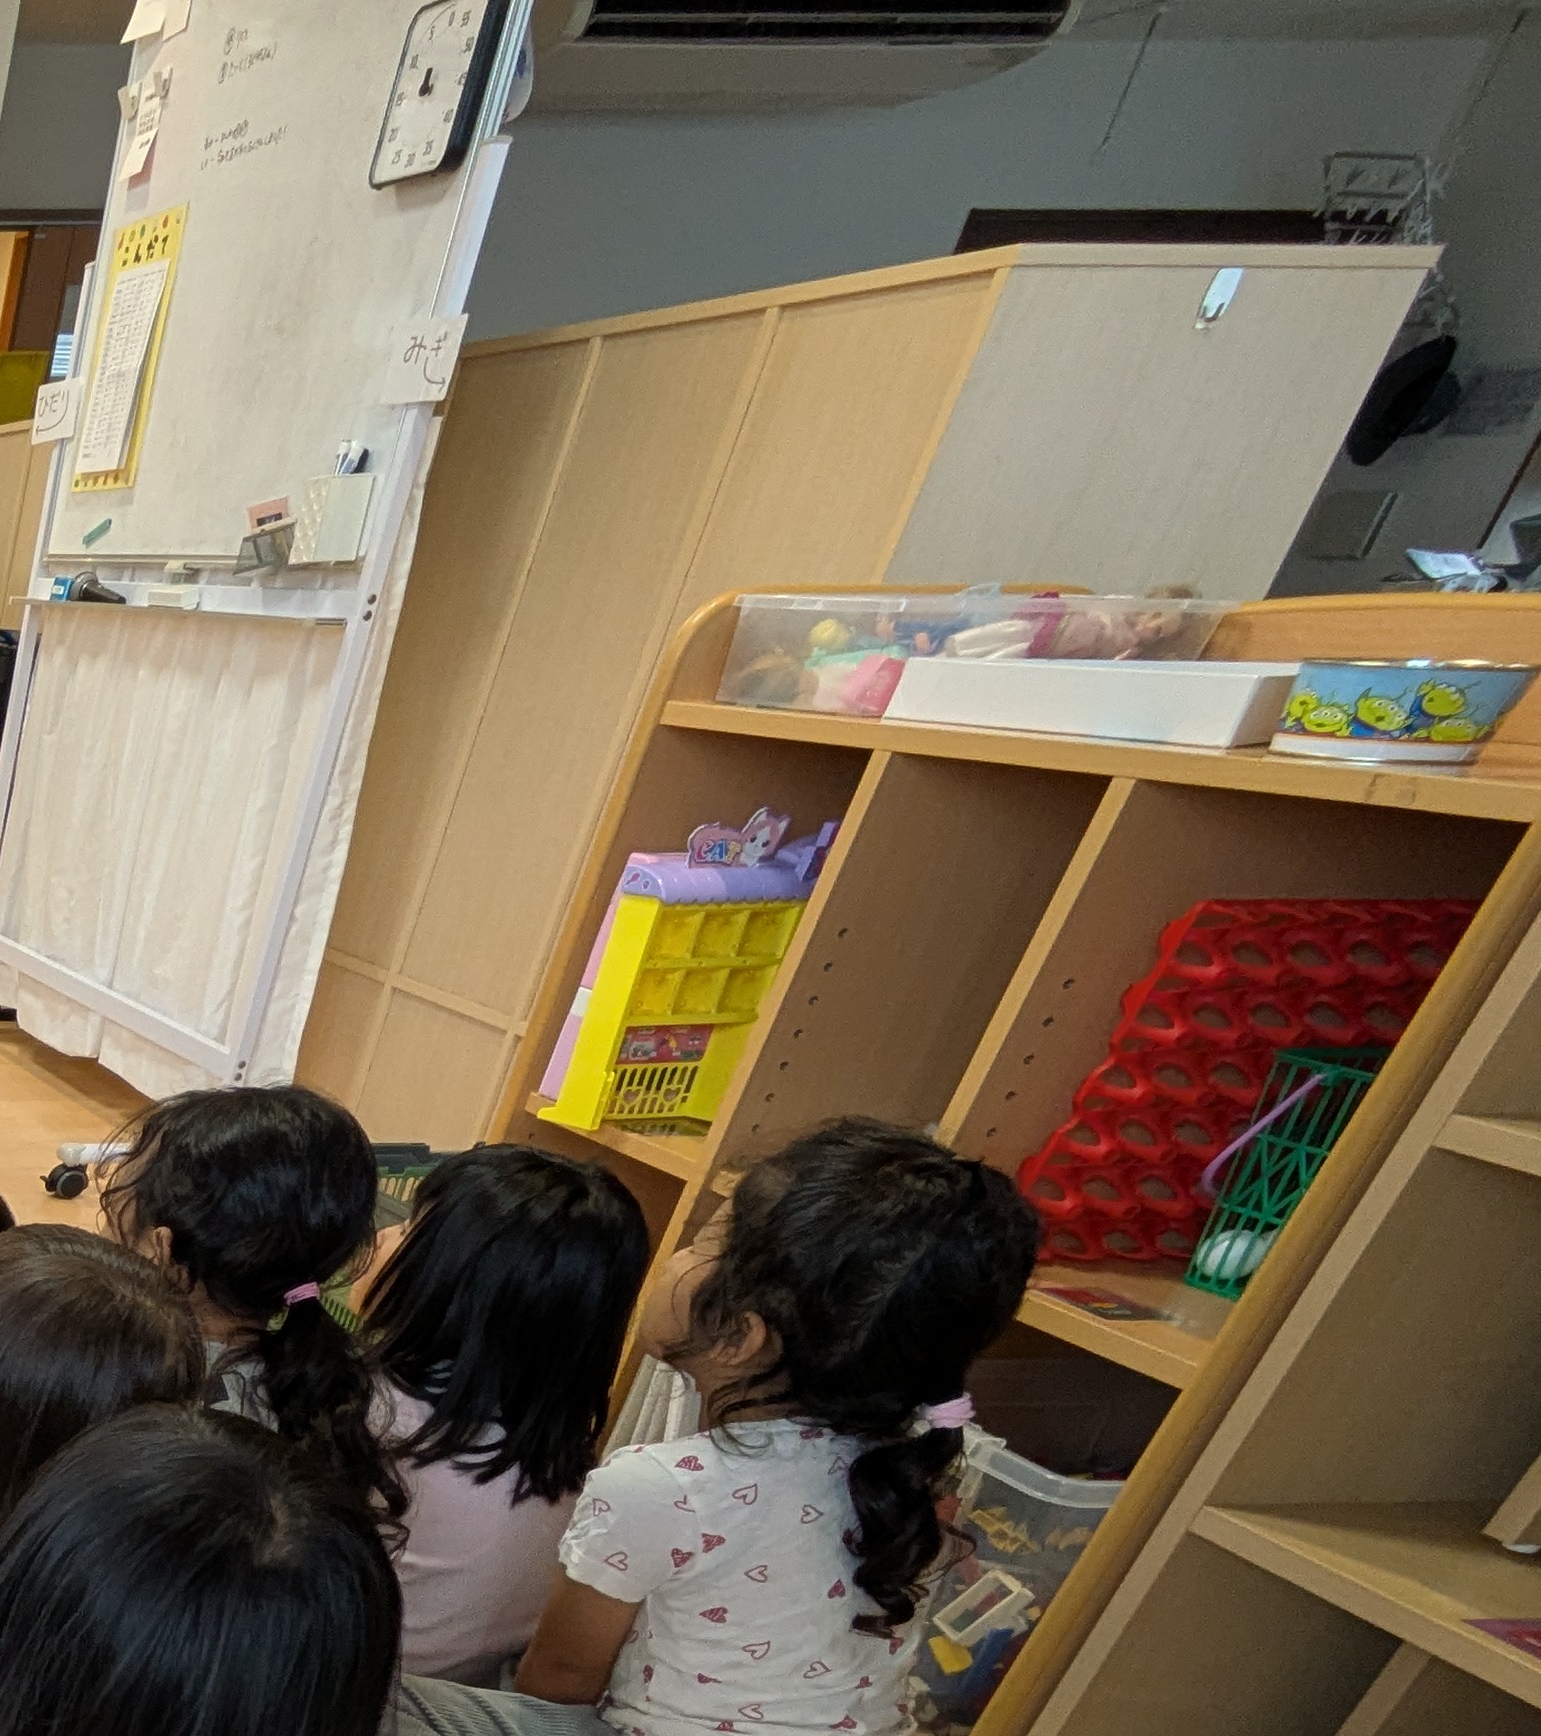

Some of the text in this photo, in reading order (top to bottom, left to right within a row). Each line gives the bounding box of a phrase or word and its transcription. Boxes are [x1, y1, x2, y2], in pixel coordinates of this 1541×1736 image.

[121, 233, 169, 268] こんだて
[695, 839, 743, 865] CAT
